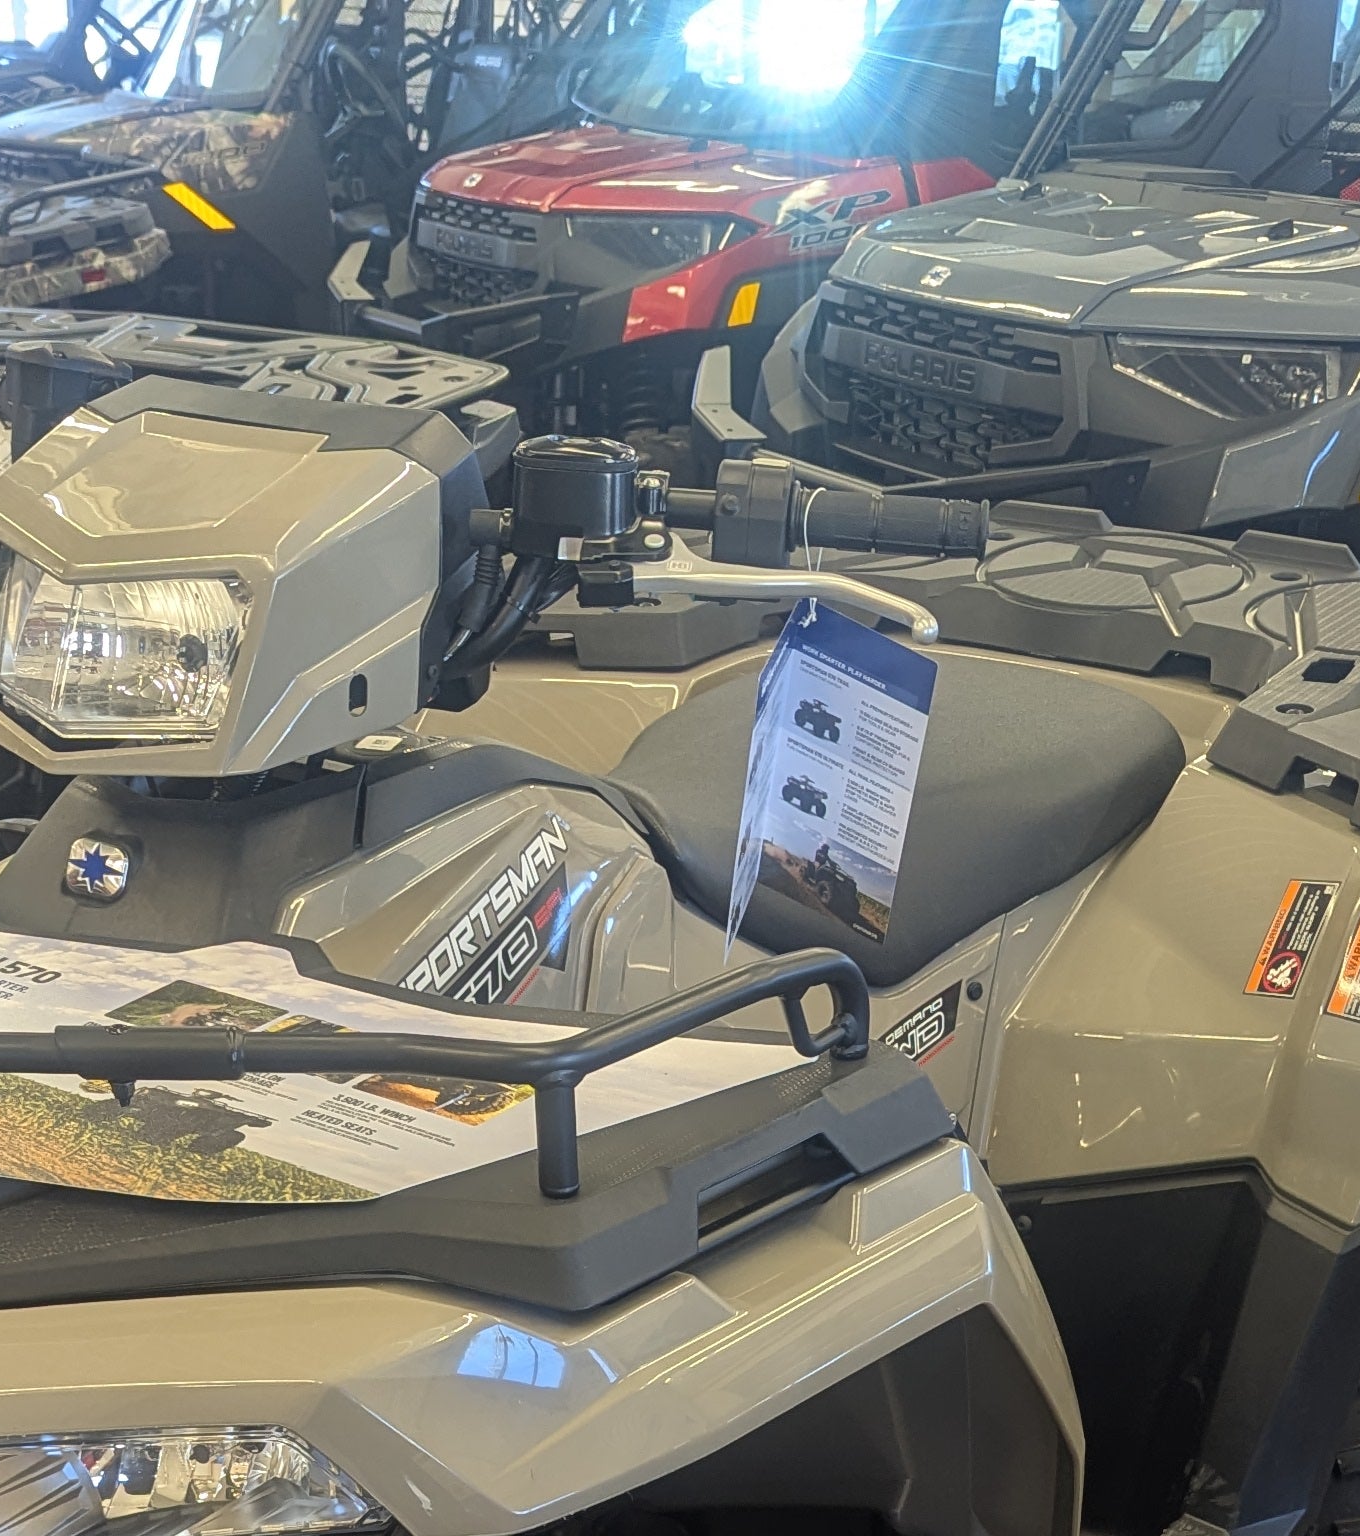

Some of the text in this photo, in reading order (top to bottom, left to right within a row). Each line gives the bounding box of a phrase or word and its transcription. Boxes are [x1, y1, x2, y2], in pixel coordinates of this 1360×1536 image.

[766, 188, 892, 238] XP
[863, 340, 977, 395] POLARIS
[399, 816, 569, 993] PORTSMAN
[1262, 907, 1288, 958] WARNING
[0, 960, 62, 984] 570
[453, 916, 538, 1005] 70
[885, 997, 943, 1046] DEMAND
[892, 1011, 946, 1059] WD
[301, 1109, 344, 1131] HEATED
[342, 1118, 378, 1137] SEATS
[332, 1093, 362, 1113] 3,500
[379, 1104, 417, 1124] WINCH
